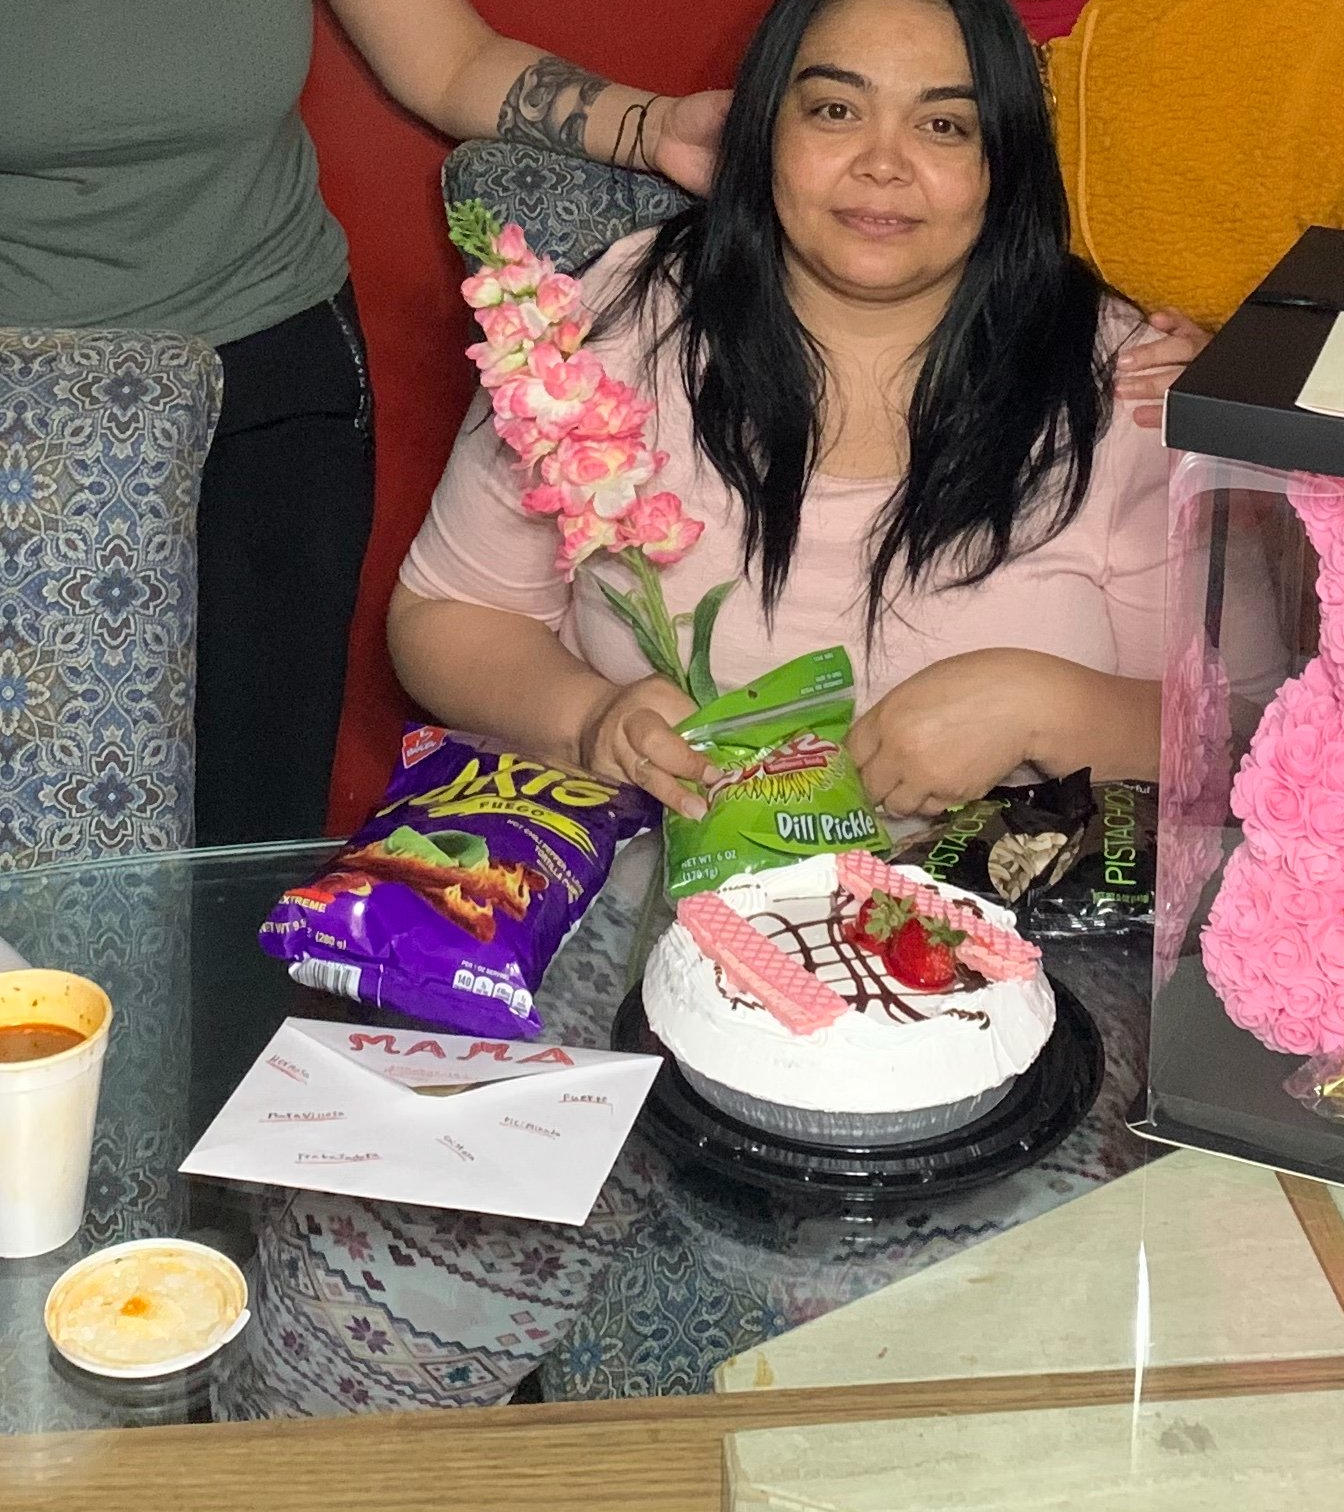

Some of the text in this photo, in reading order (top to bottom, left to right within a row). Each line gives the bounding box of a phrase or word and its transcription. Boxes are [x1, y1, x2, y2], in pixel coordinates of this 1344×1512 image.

[479, 801, 545, 817] FUEGO
[776, 809, 876, 841] Dill Pickle
[534, 844, 563, 881] TORTILLA
[724, 849, 736, 860] OZ
[274, 921, 290, 935] WT
[348, 1033, 575, 1065] MAMA
